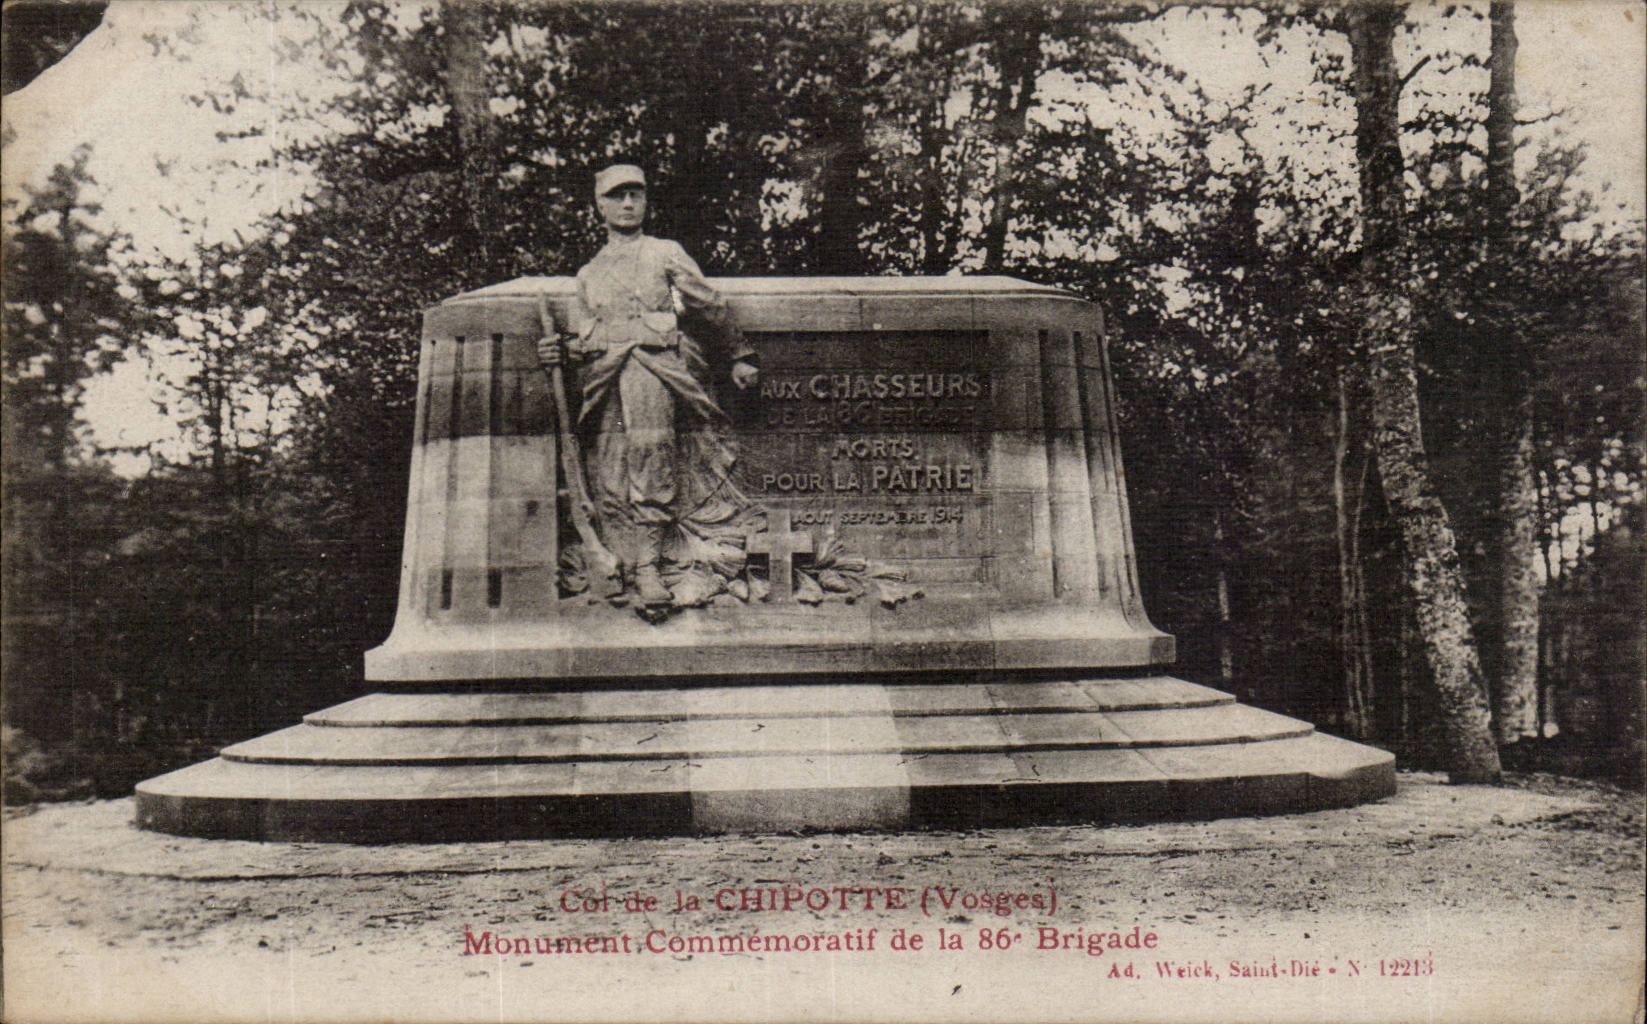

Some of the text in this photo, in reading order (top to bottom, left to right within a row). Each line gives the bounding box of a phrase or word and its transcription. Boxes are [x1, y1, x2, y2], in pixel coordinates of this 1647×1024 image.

[760, 373, 982, 399] AUX CHASSEURS
[803, 406, 831, 425] LA
[761, 464, 973, 492] POUR LA PATRIE
[930, 505, 965, 525] 1914
